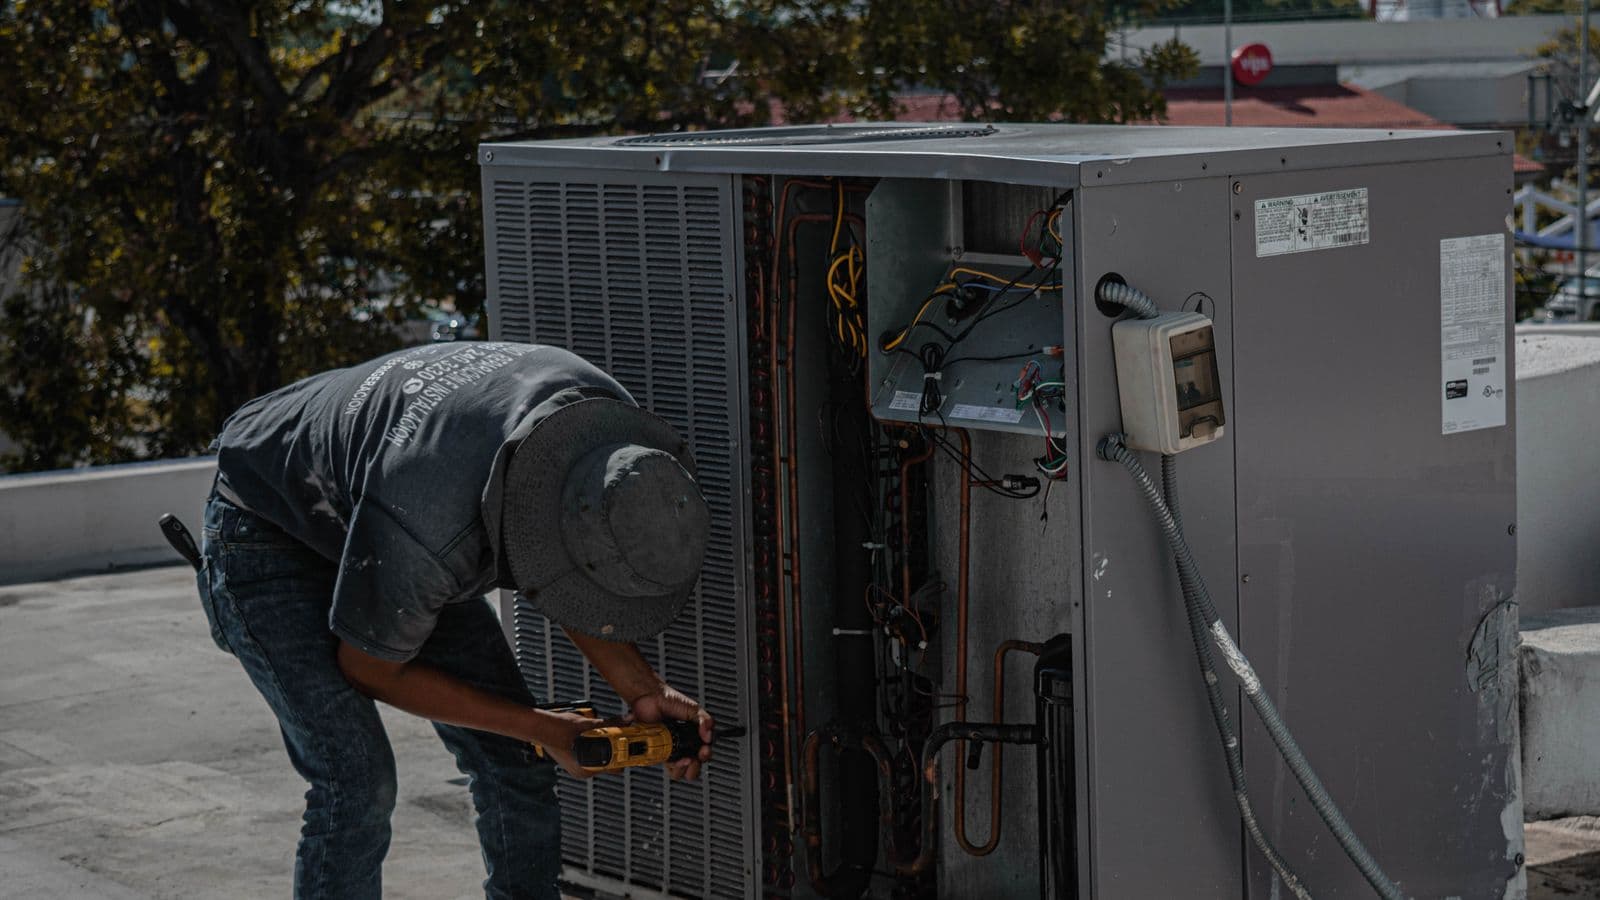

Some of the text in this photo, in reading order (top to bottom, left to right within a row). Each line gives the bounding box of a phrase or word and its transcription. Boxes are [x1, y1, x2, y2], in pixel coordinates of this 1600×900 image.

[451, 348, 486, 364] 240
[417, 359, 460, 381] 3230
[385, 382, 452, 447] INSTALACIÓN
